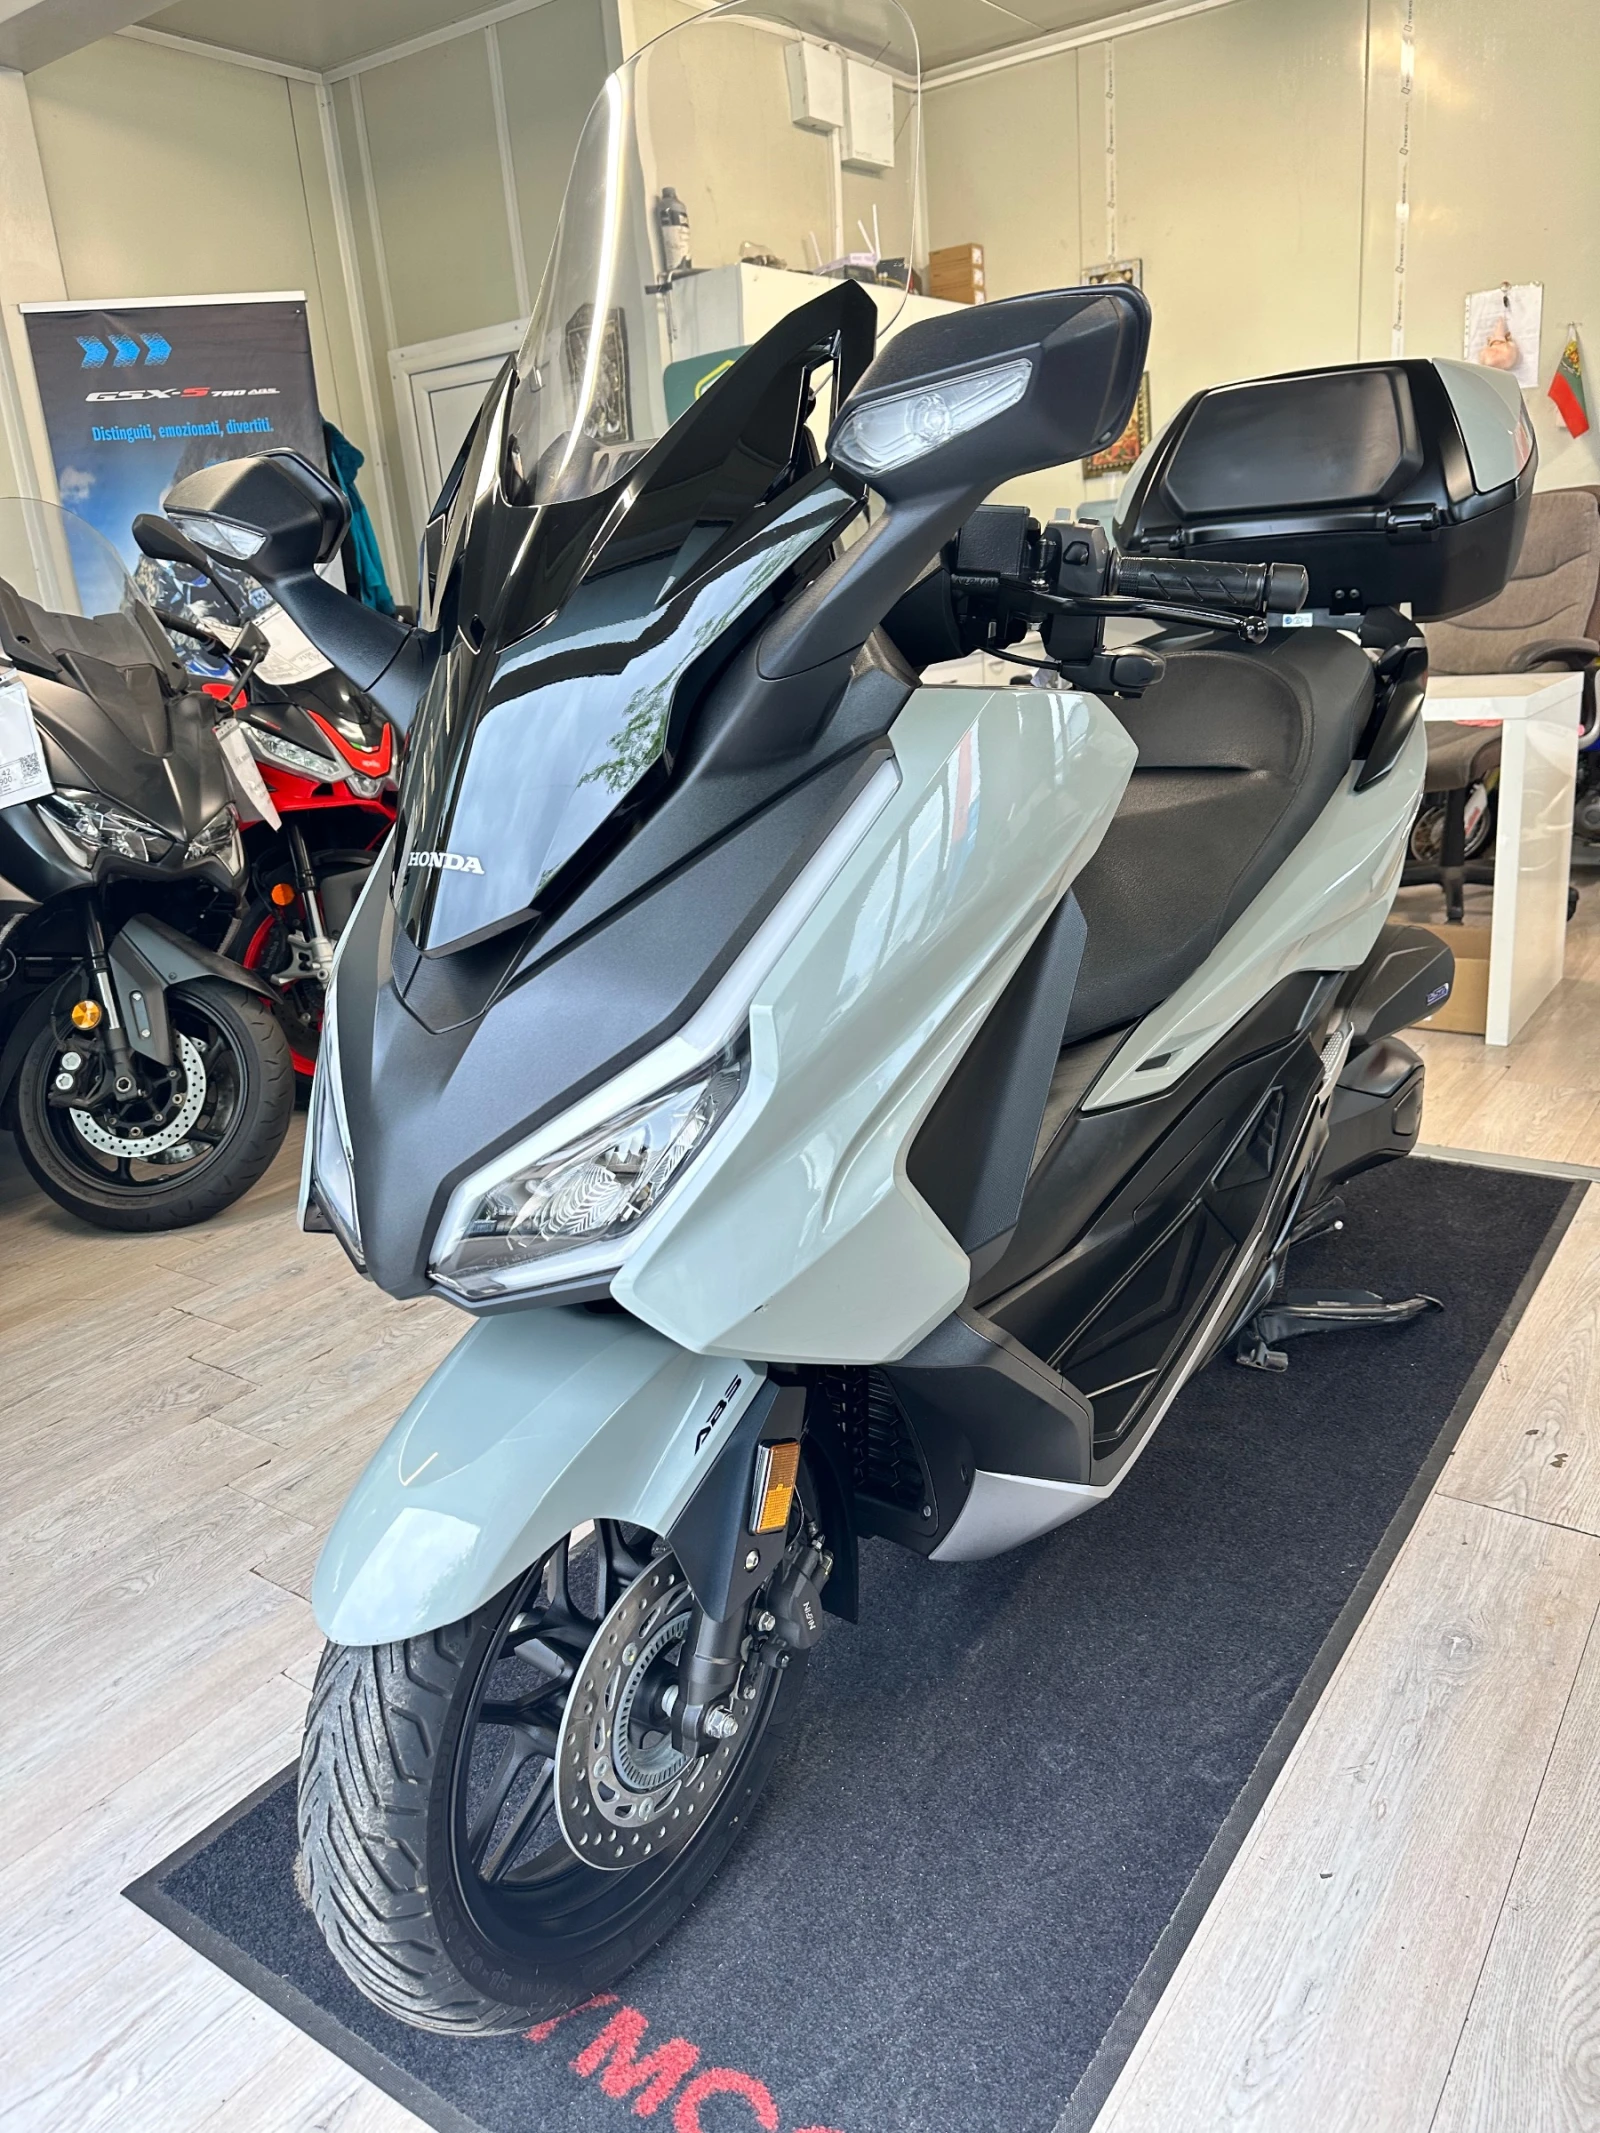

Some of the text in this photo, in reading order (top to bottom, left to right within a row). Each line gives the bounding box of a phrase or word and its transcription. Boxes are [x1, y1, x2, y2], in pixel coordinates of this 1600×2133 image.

[86, 387, 210, 402] GSX-S
[92, 417, 274, 443] Distinguiti, emozionati, divertiti.
[408, 851, 485, 875] HONDA
[694, 1374, 742, 1456] ABS
